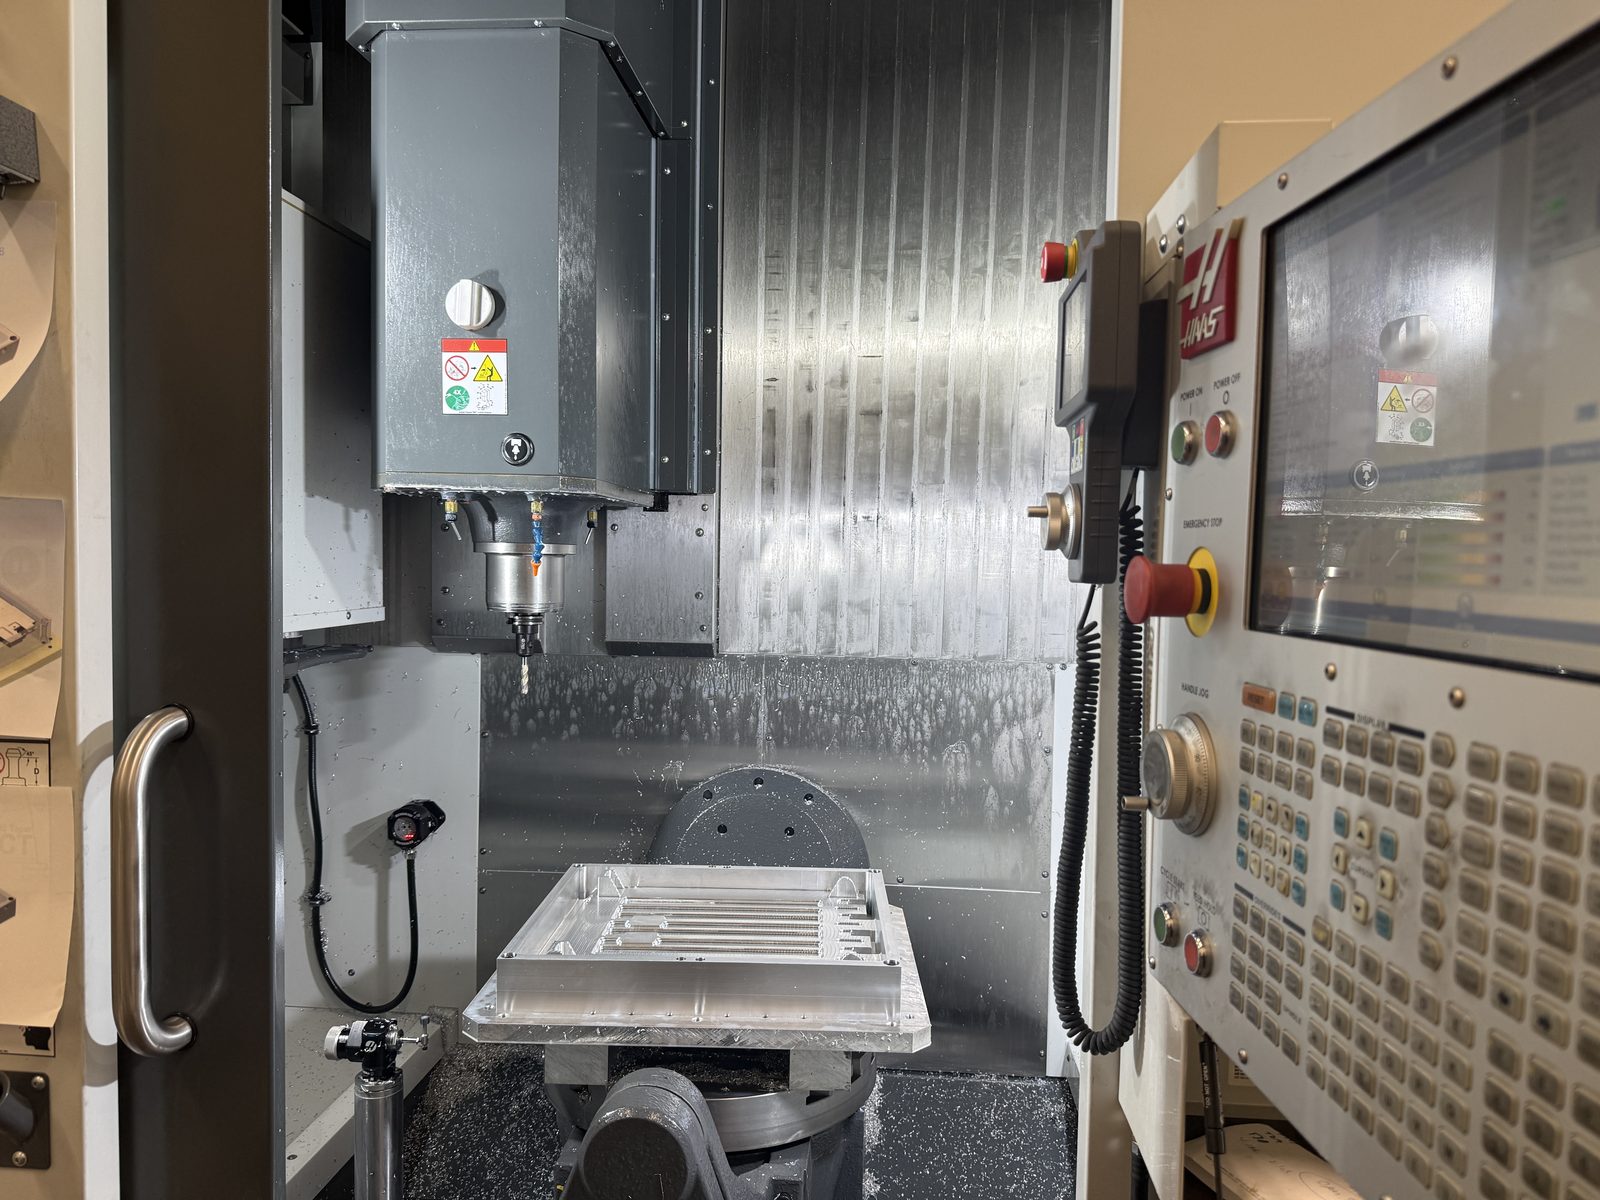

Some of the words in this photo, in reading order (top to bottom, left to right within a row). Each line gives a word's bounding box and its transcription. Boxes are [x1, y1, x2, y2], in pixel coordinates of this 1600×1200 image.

[1180, 305, 1225, 348] HAAS
[1213, 376, 1230, 391] POWER
[1231, 372, 1241, 384] OFF
[1180, 389, 1195, 401] POWER
[1195, 386, 1203, 397] ON
[1183, 518, 1210, 529] EMERGENCY
[1210, 517, 1222, 528] STOP
[1181, 683, 1198, 696] HANDLE
[1198, 687, 1209, 699] JOG
[34, 767, 40, 775] D
